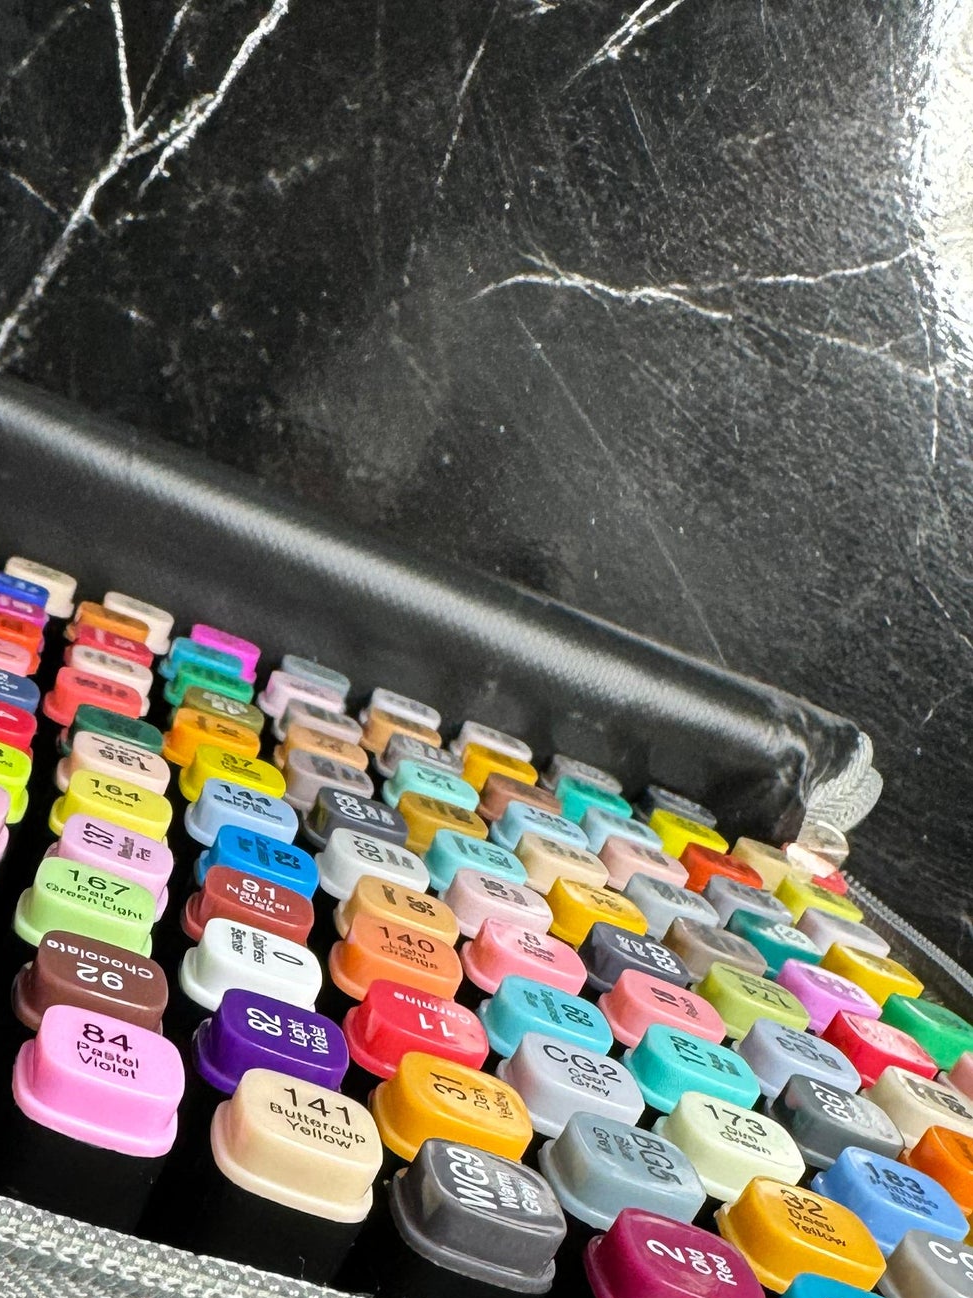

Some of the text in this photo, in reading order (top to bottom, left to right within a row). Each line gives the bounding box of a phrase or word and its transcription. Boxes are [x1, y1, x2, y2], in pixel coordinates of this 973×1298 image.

[90, 778, 143, 802] 164
[219, 784, 272, 807] 144
[82, 822, 115, 850] 137
[68, 869, 131, 896] 167
[77, 884, 115, 902] Pale
[241, 878, 276, 900] 91
[45, 882, 144, 921] Green Light
[226, 883, 290, 913] Natural
[239, 894, 276, 916] Oak
[378, 926, 435, 953] 140
[272, 951, 304, 967] 0
[76, 961, 124, 991] 92
[246, 1007, 283, 1037] 82
[393, 990, 472, 1025] Carmine
[561, 1003, 594, 1028] 68
[82, 1023, 133, 1053] 84
[287, 1018, 312, 1048] Light
[418, 1012, 456, 1038] 11
[77, 1041, 139, 1069] Pastel
[78, 1052, 137, 1080] Violet
[543, 1044, 621, 1083] CG2
[670, 1035, 707, 1067] 179
[429, 1071, 468, 1101] 31
[568, 1067, 606, 1086] Cool
[284, 1087, 351, 1126] 141
[703, 1103, 767, 1138] 173
[269, 1102, 366, 1144] Buttercup
[286, 1119, 352, 1150] Yellow
[630, 1132, 683, 1186] BG5
[446, 1146, 498, 1211] WG9
[496, 1170, 520, 1210] Warm
[863, 1162, 925, 1195] 183
[781, 1189, 828, 1221] 32
[646, 1239, 686, 1264] 2
[684, 1247, 712, 1275] Old
[707, 1252, 738, 1286] Red
